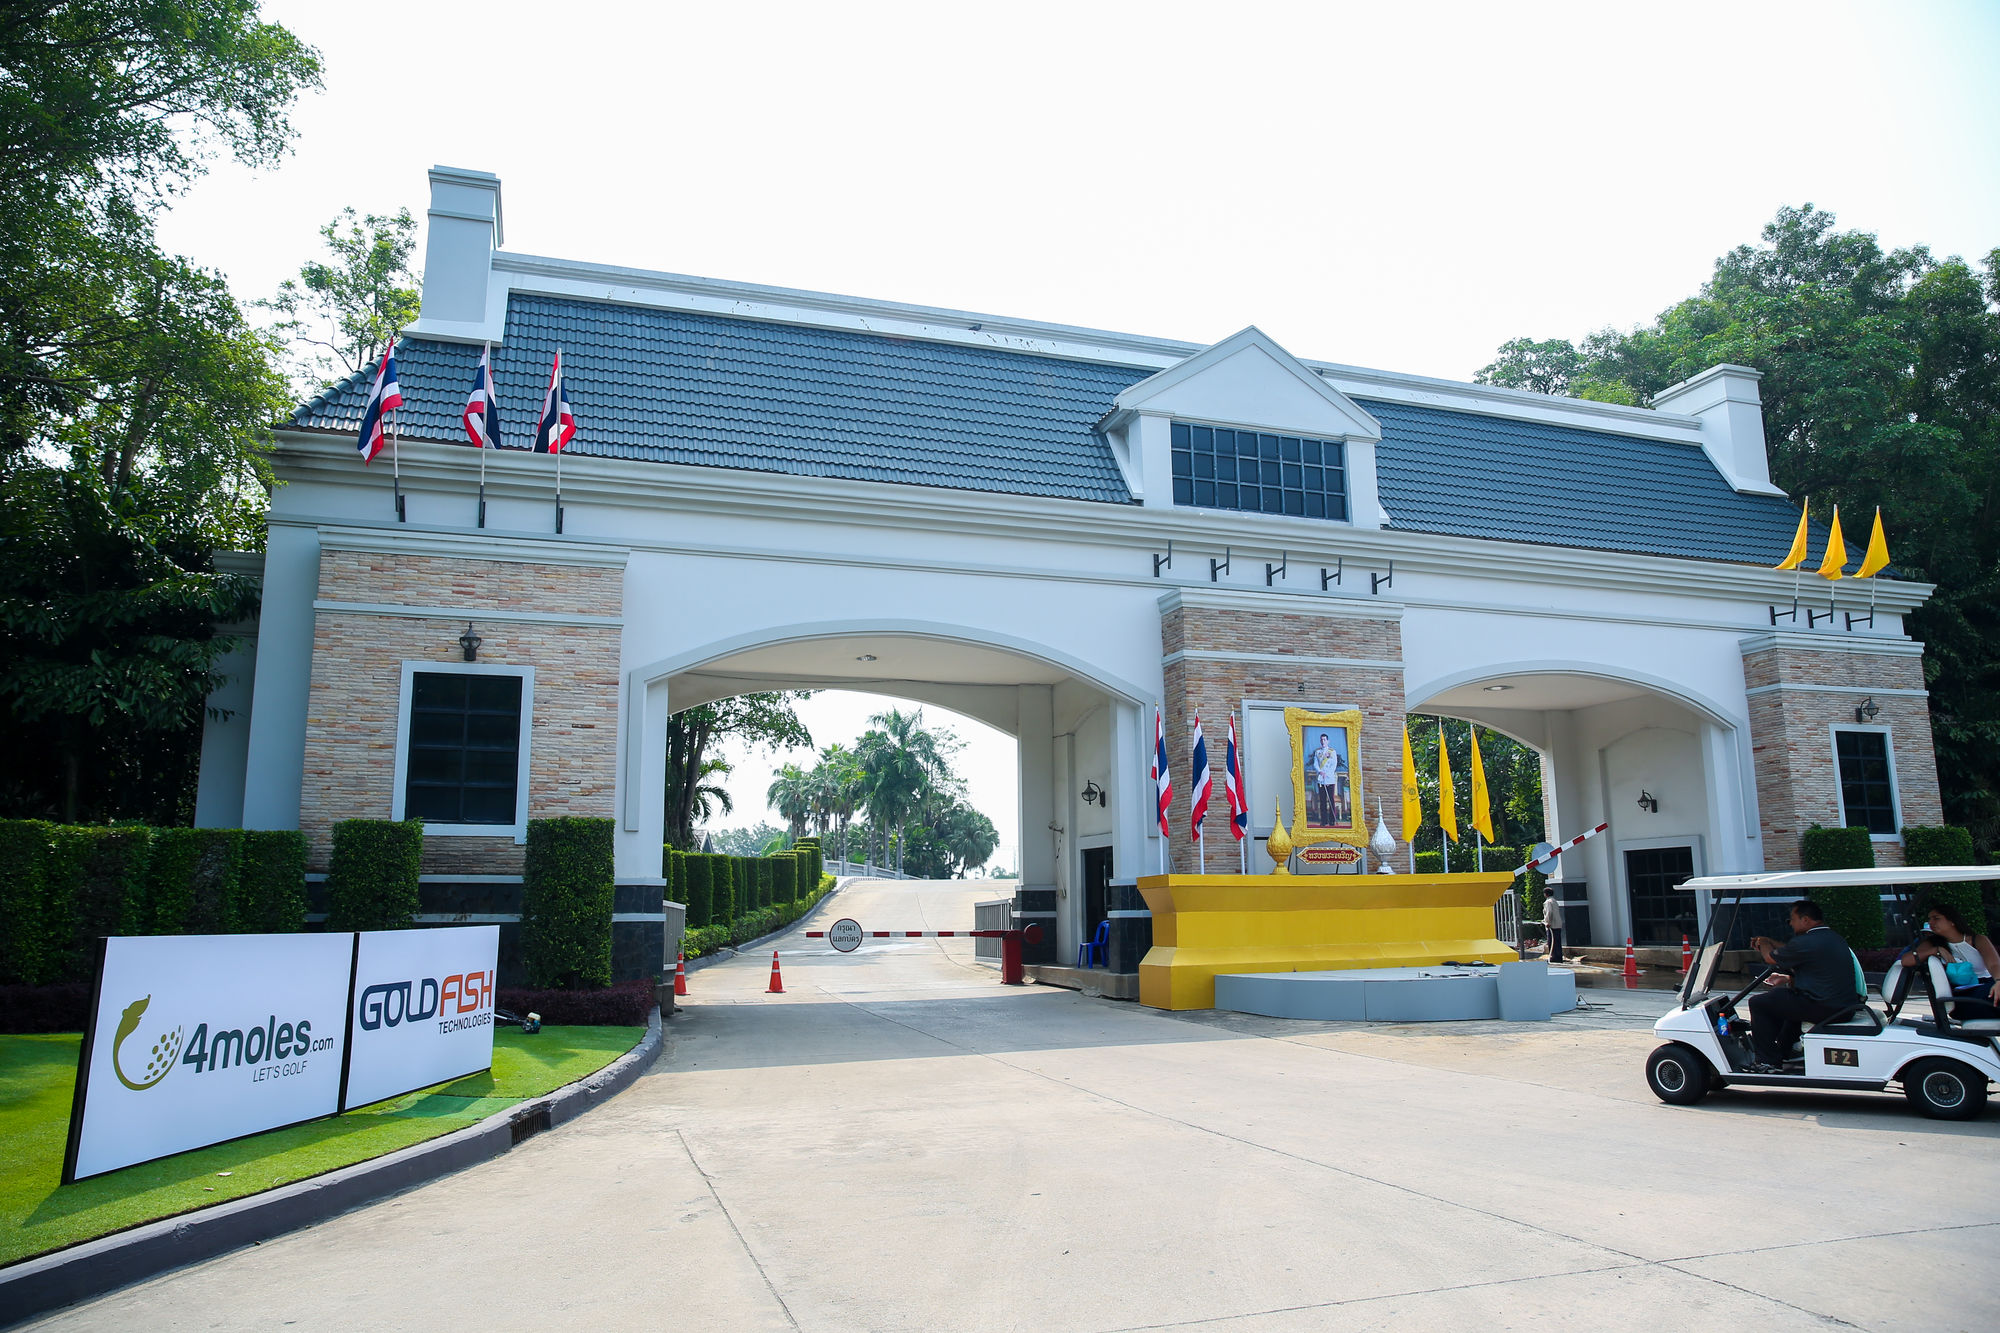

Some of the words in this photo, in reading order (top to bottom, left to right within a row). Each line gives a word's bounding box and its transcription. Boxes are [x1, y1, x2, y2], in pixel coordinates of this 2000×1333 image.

[837, 925, 856, 933] กรุณา
[439, 1012, 492, 1035] TECHNOLOGIES
[252, 1065, 281, 1083] LET'S
[282, 1060, 308, 1077] GOLF
